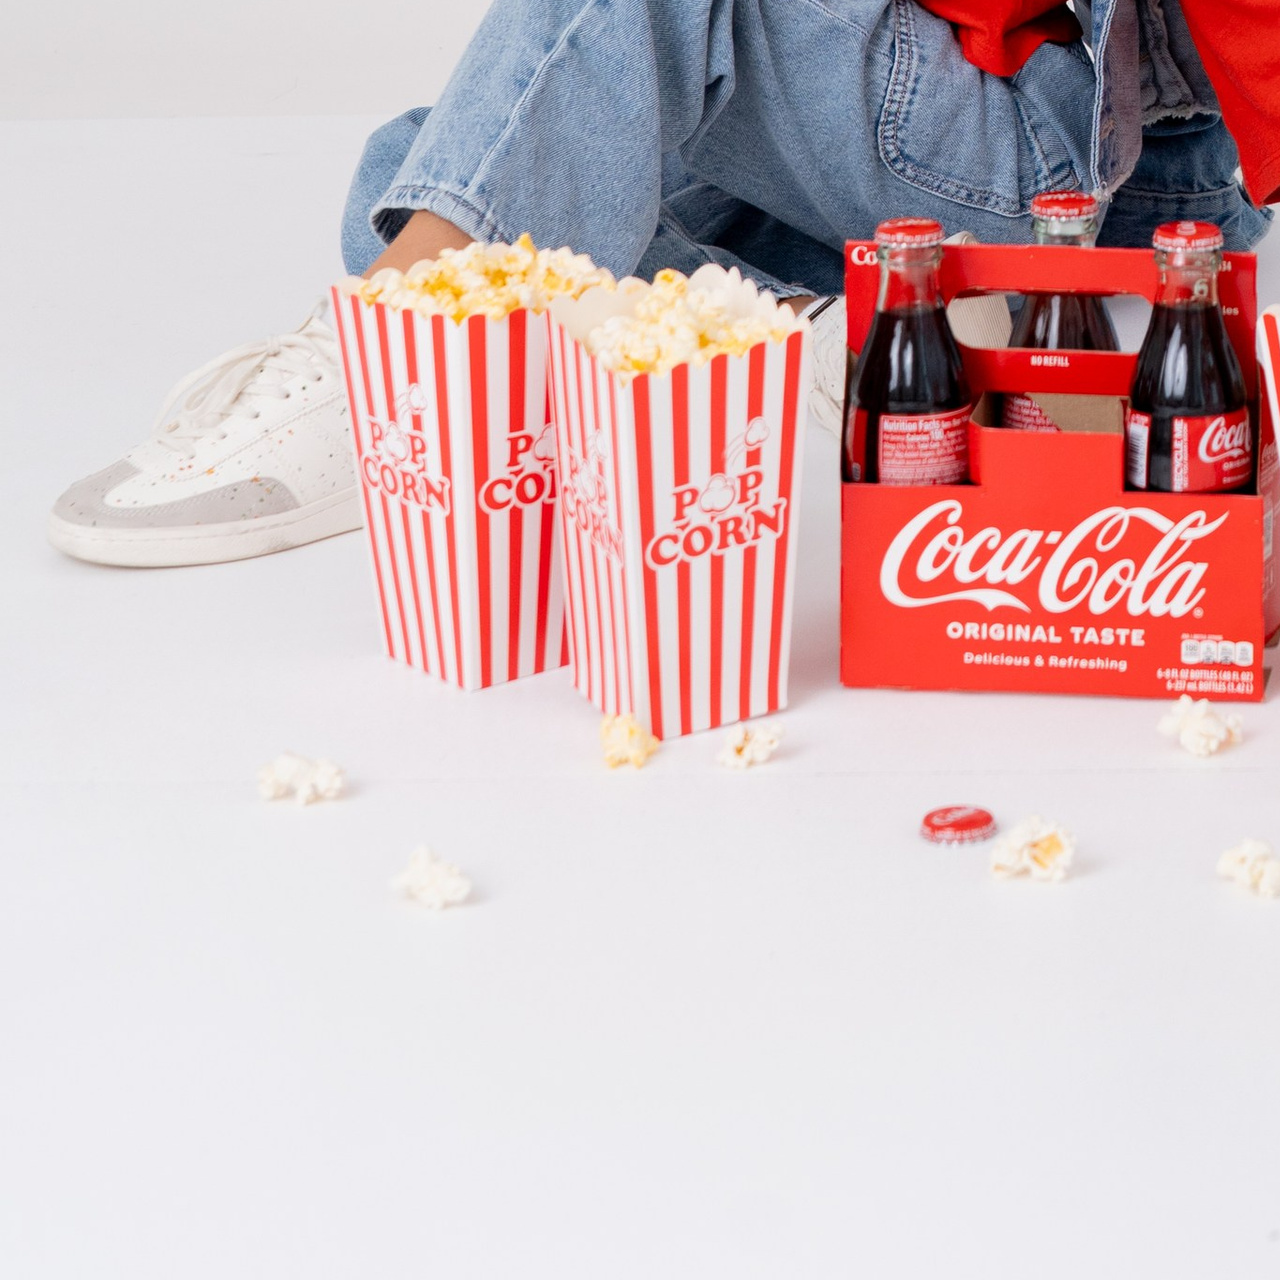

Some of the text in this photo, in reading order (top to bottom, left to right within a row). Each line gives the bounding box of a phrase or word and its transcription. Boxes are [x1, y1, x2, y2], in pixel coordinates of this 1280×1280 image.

[1030, 355, 1070, 368] NO REFILL
[1173, 418, 1184, 492] RECYCLE ME
[363, 456, 448, 511] CORN
[483, 469, 557, 512] CO
[651, 504, 781, 566] CORN
[880, 499, 1229, 618] Coca-Cola
[946, 621, 1146, 647] ORIGINAL TASTE
[963, 651, 1128, 673] Delicious & Refreshing
[1190, 669, 1218, 681] BOTTLES
[1198, 681, 1226, 693] BOTTLES
